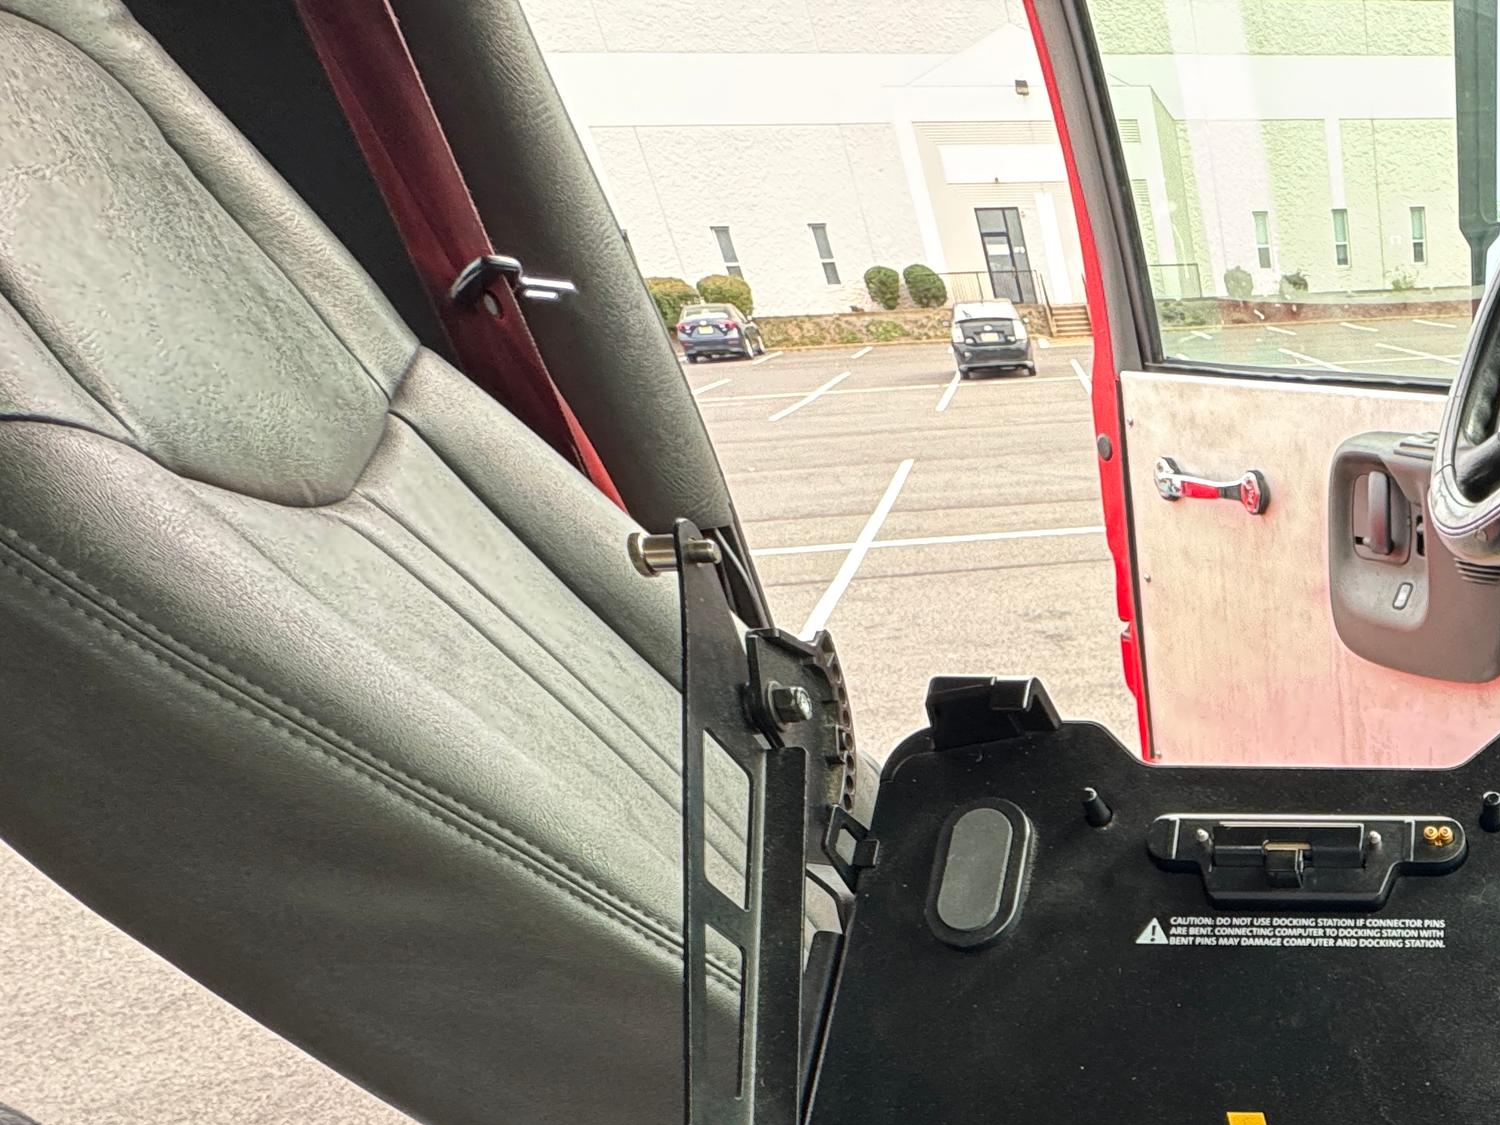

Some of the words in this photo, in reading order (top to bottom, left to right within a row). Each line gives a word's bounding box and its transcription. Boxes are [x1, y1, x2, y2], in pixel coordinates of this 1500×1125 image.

[1170, 916, 1214, 926] CAUTION:
[1216, 917, 1231, 926] DO
[1233, 917, 1252, 926] NOT
[1253, 917, 1271, 926] USE
[1273, 917, 1316, 927] DOCKING
[1317, 918, 1355, 927] STATION
[1356, 918, 1365, 927] IF
[1366, 918, 1423, 928] CONNECTOR
[1424, 919, 1446, 928] PINS
[1170, 926, 1188, 935] ARE
[1189, 927, 1213, 936] BENT.
[1214, 927, 1274, 936] CONNECTING
[1275, 928, 1324, 937] COMPUTER
[1325, 928, 1337, 937] TO
[1338, 928, 1381, 938] DOCKING
[1382, 929, 1418, 938] STATION
[1419, 929, 1444, 938] WITH
[1170, 937, 1194, 946] BENT
[1195, 937, 1217, 946] PINS
[1218, 937, 1240, 946] MAY
[1241, 937, 1282, 946] DAMAGE
[1283, 938, 1334, 947] COMPUTER
[1336, 938, 1357, 947] AND
[1359, 939, 1403, 948] DOCKING
[1404, 939, 1446, 948] STATION.
